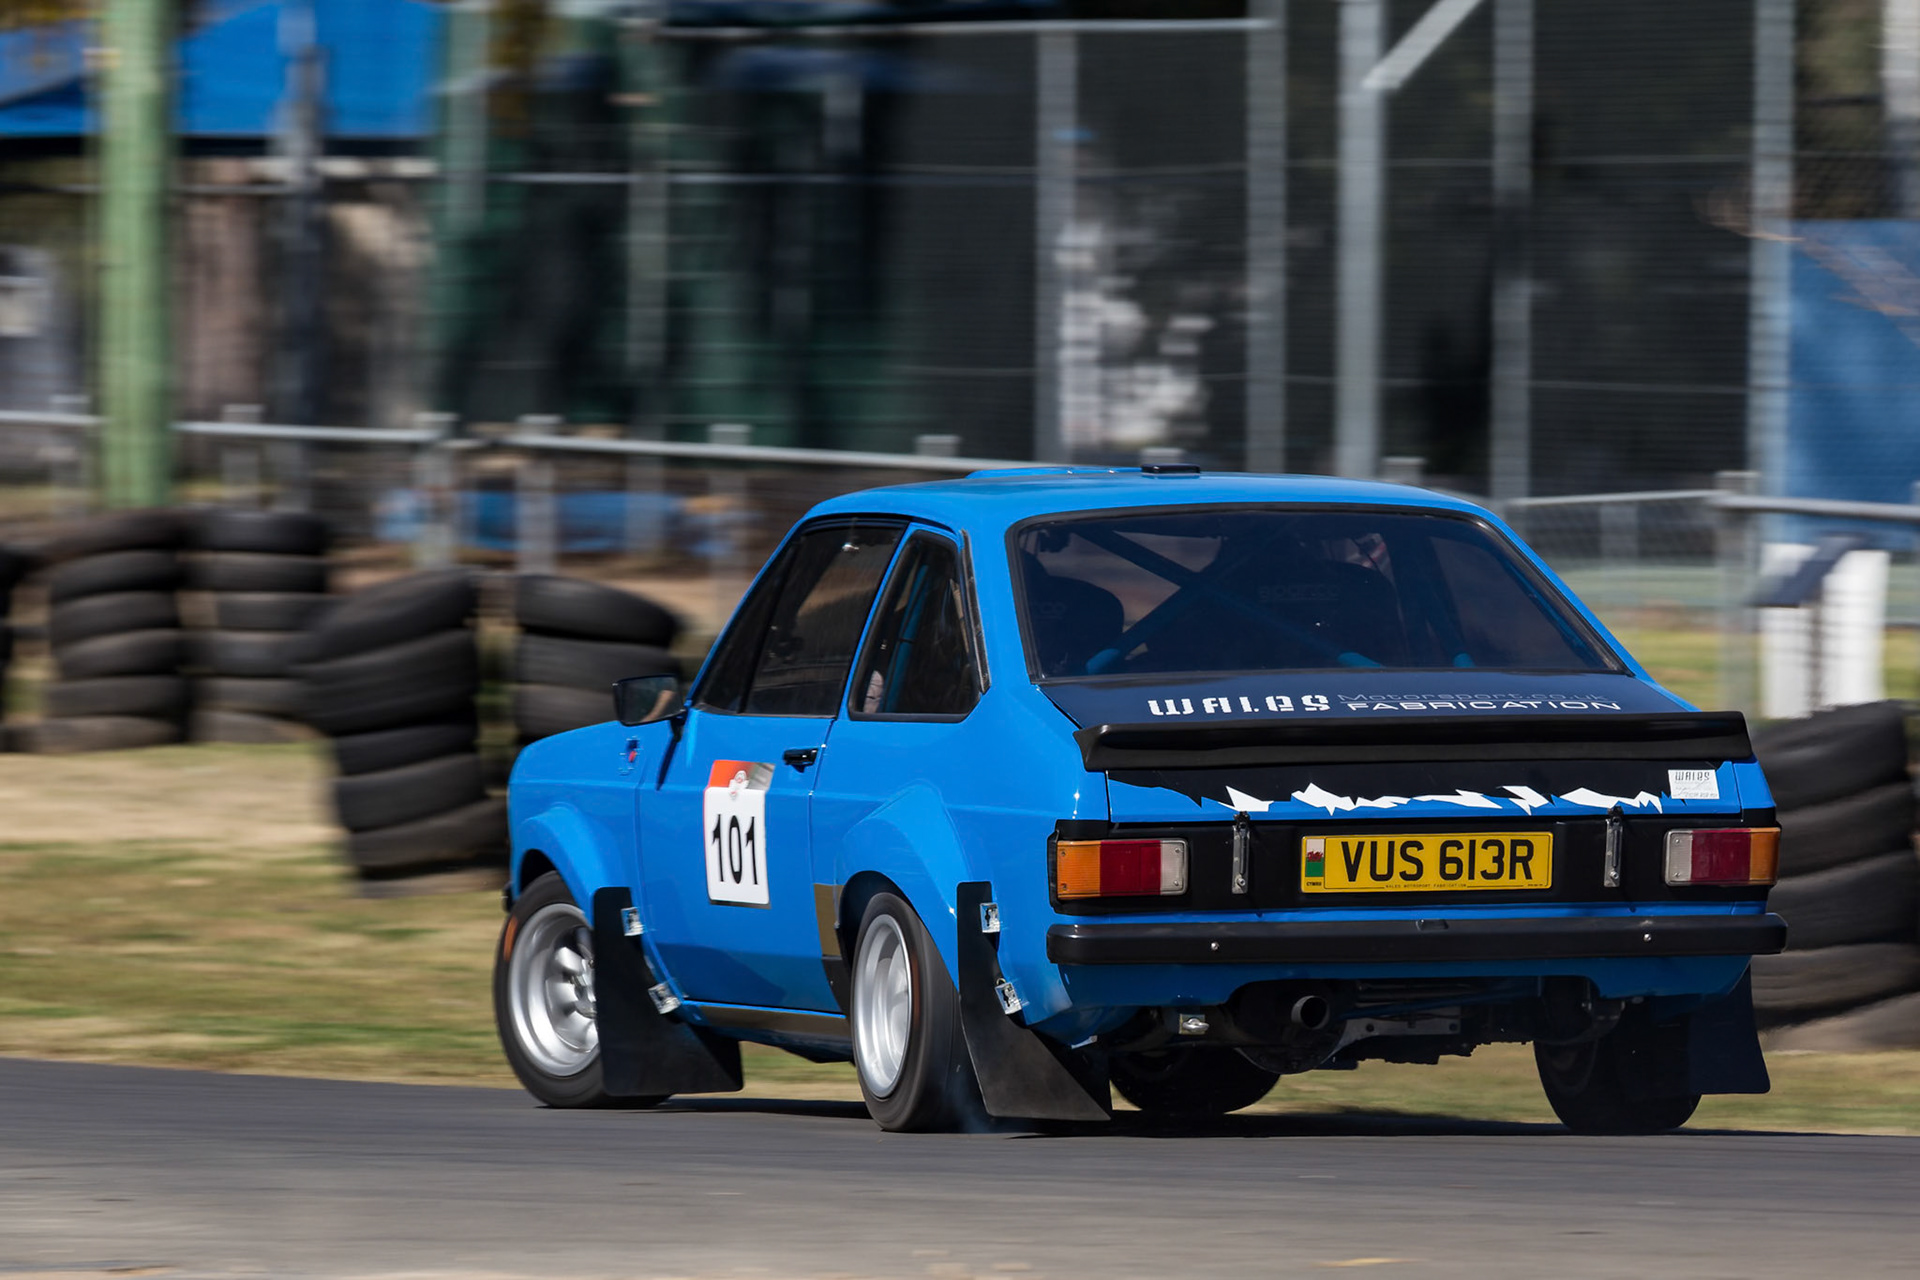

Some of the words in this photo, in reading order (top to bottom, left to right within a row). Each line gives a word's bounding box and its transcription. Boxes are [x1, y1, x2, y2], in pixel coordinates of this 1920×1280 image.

[1347, 700, 1622, 711] FABRICATION
[712, 813, 758, 885] 101
[1341, 840, 1424, 882] VUS
[1439, 839, 1534, 880] 613R
